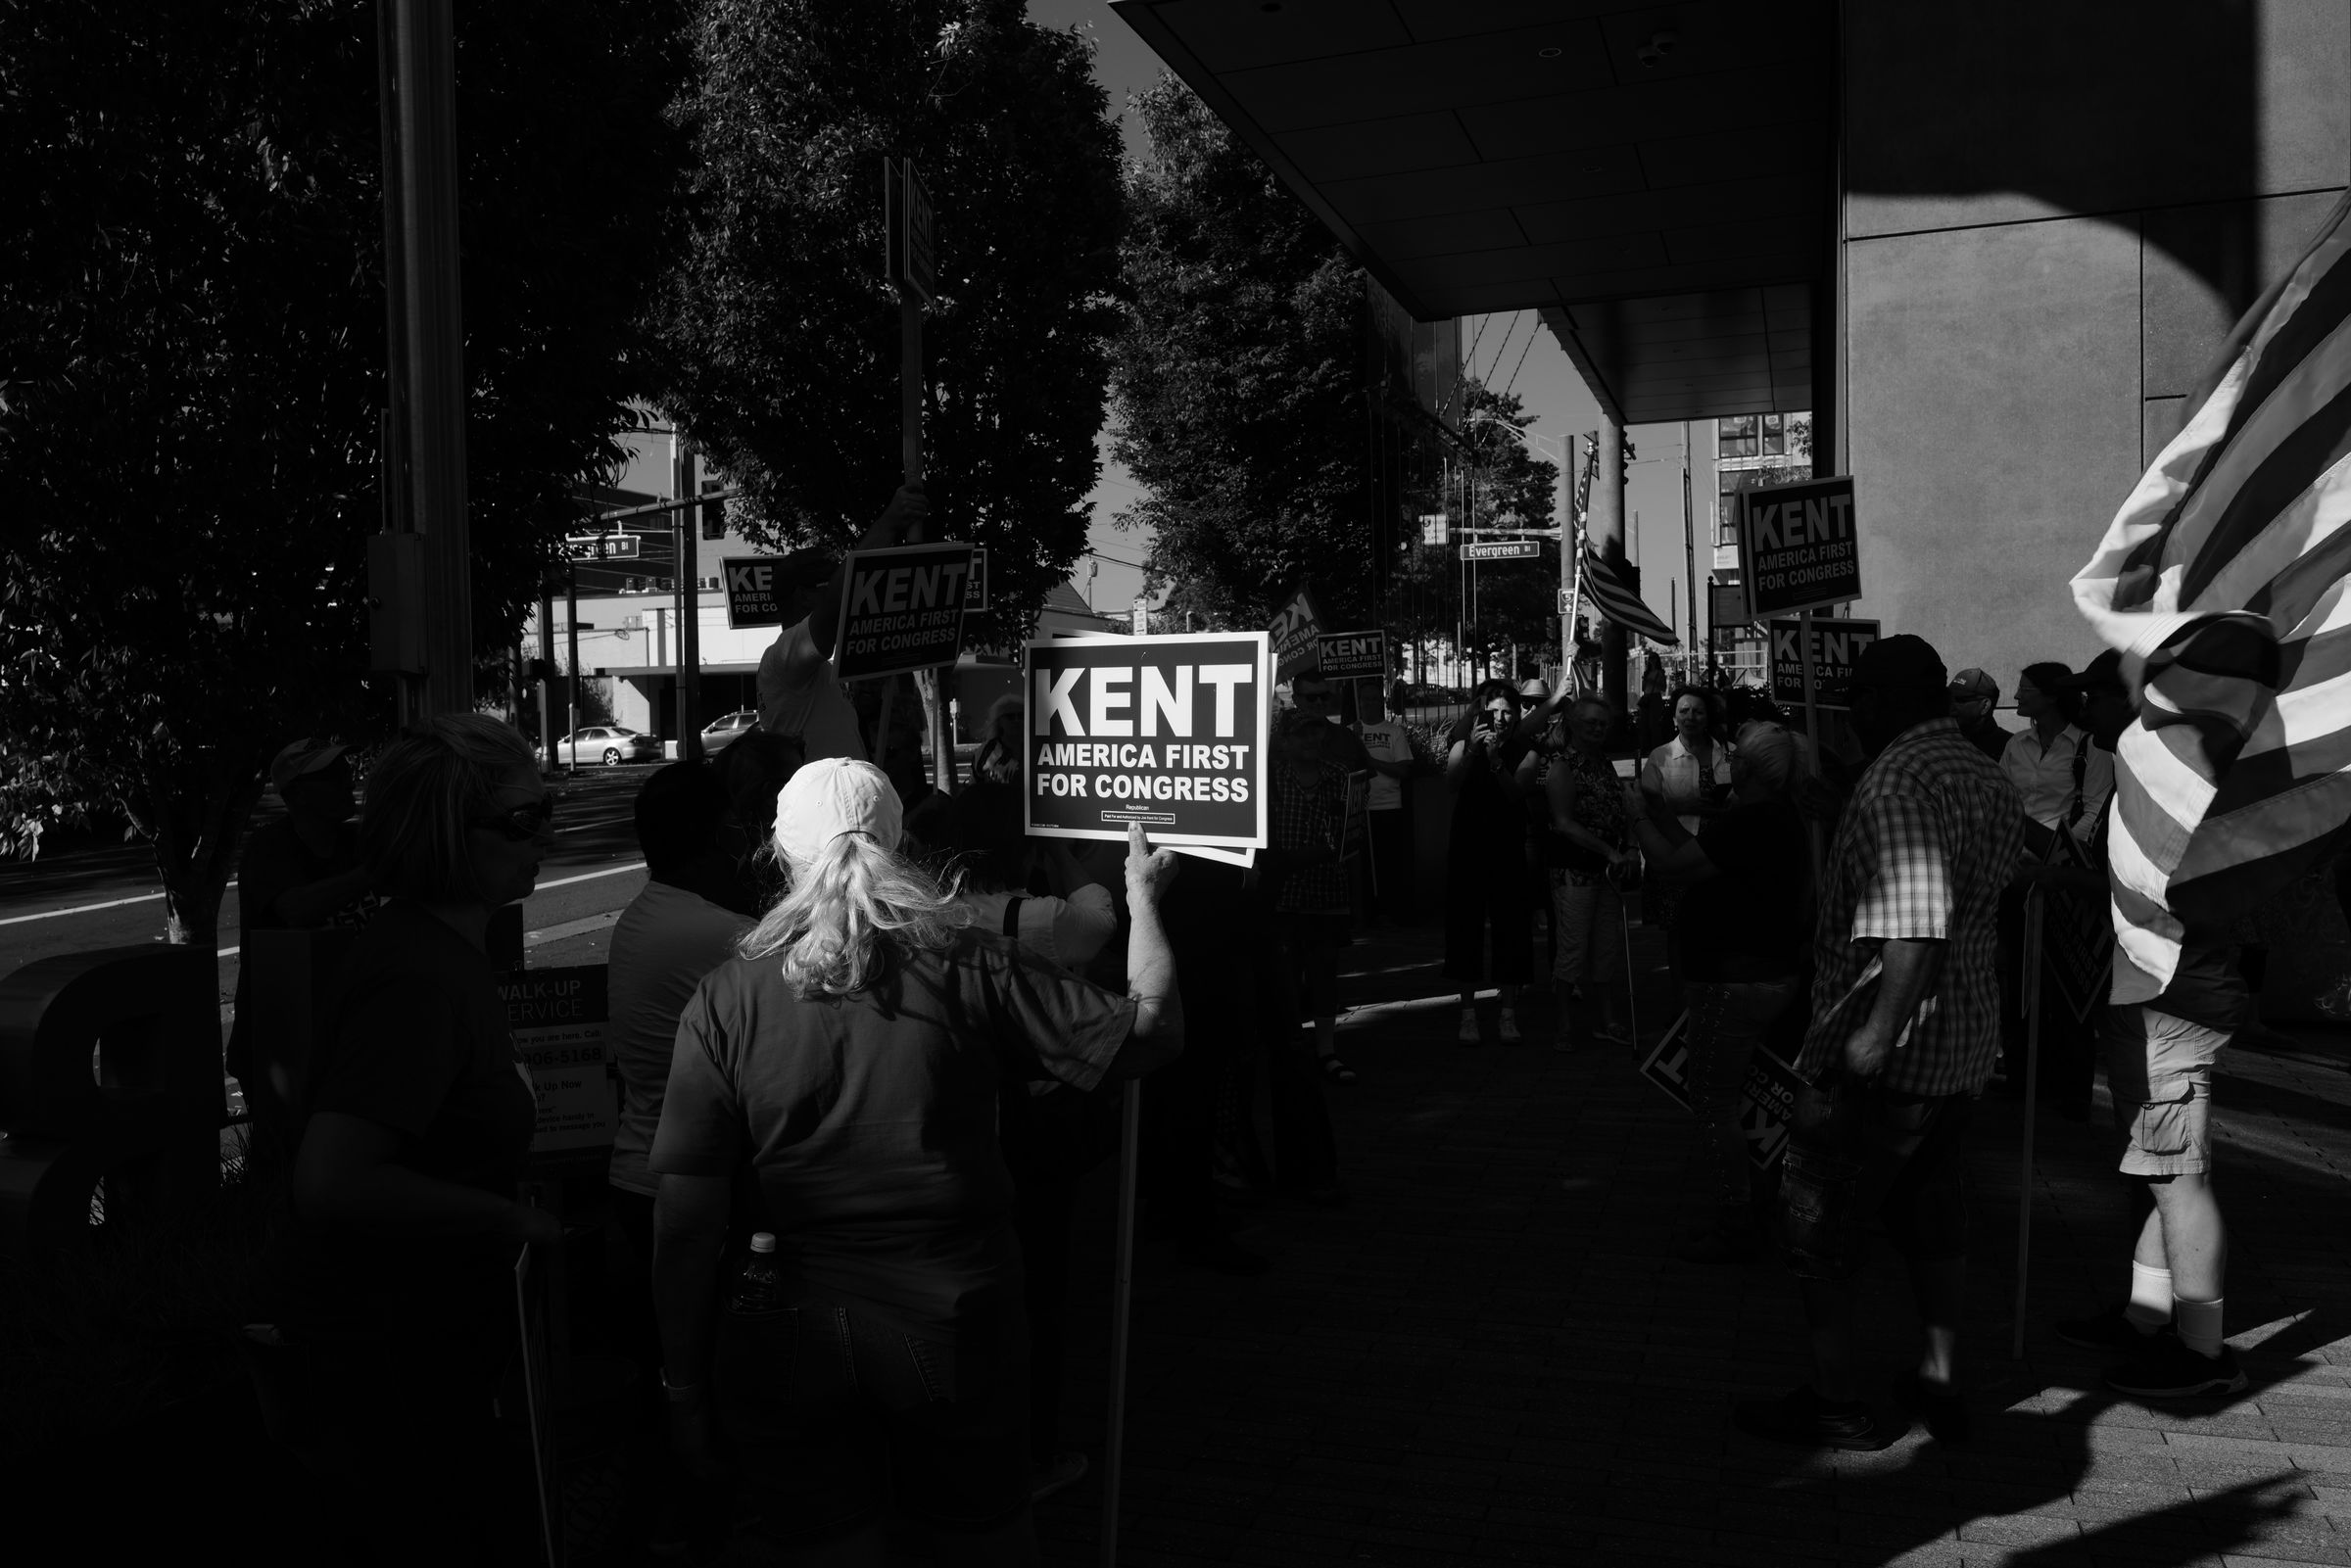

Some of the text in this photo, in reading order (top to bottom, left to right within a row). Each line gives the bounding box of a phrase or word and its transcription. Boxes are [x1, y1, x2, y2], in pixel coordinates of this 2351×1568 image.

[1752, 493, 1852, 553] KENT
[1469, 545, 1520, 558] Evergreen
[1757, 541, 1853, 572] AMERICA FIRST
[728, 566, 773, 592] KE
[1758, 560, 1855, 593] FOR CONGRESS
[735, 593, 774, 602] AMERI
[849, 562, 967, 618] KENT
[735, 603, 759, 614] FOR
[849, 608, 960, 637] AMERICA FIRST
[845, 627, 957, 657] FOR CONGRESS
[1320, 637, 1381, 657] KENT
[1776, 663, 1834, 678] AMEICA
[1776, 676, 1802, 689] FOR
[1035, 664, 1253, 737] KENT
[1364, 733, 1390, 742] ENT
[1037, 743, 1250, 770] AMERICA FIRST
[1037, 773, 1249, 803] FOR CONGRESS
[507, 998, 583, 1022] ERVICE
[531, 1035, 545, 1044] you
[544, 1081, 557, 1091] Up
[561, 1080, 582, 1089] Now
[593, 1120, 605, 1129] you
